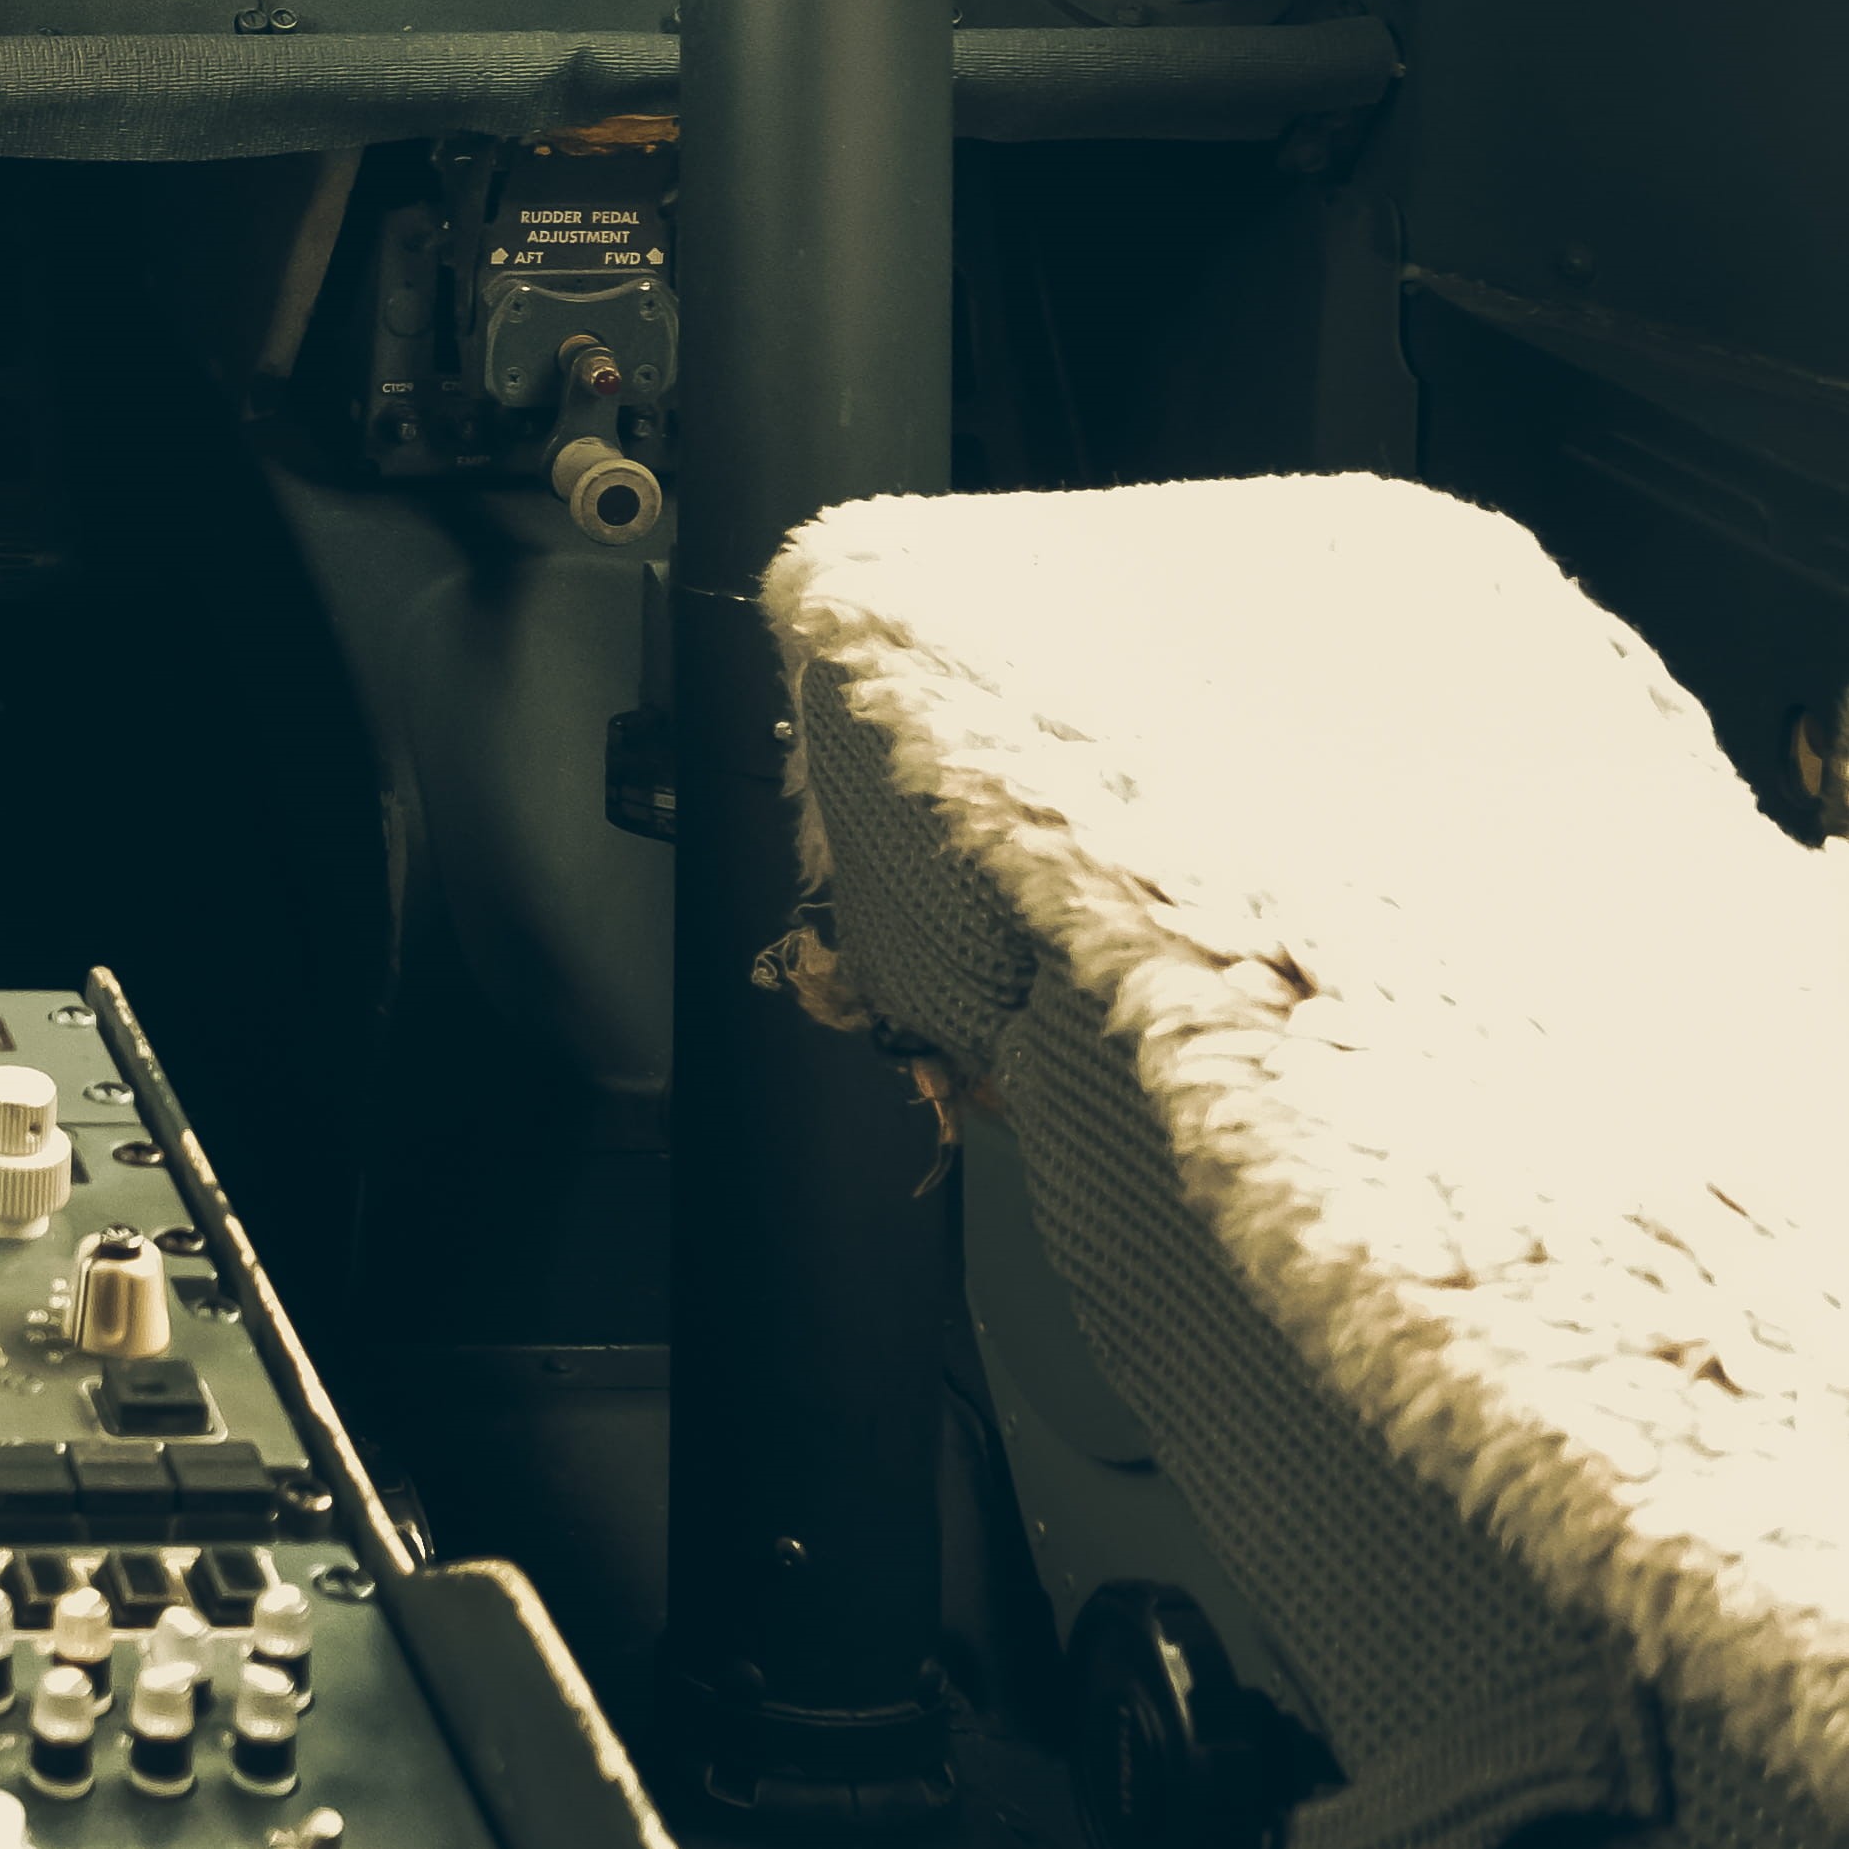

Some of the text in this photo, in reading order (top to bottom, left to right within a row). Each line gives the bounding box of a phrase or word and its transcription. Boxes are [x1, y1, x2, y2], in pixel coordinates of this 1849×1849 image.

[520, 210, 639, 225] RUDDER PEDAL
[528, 230, 630, 245] ADJUSTMENT
[514, 251, 641, 265] AFT FWD
